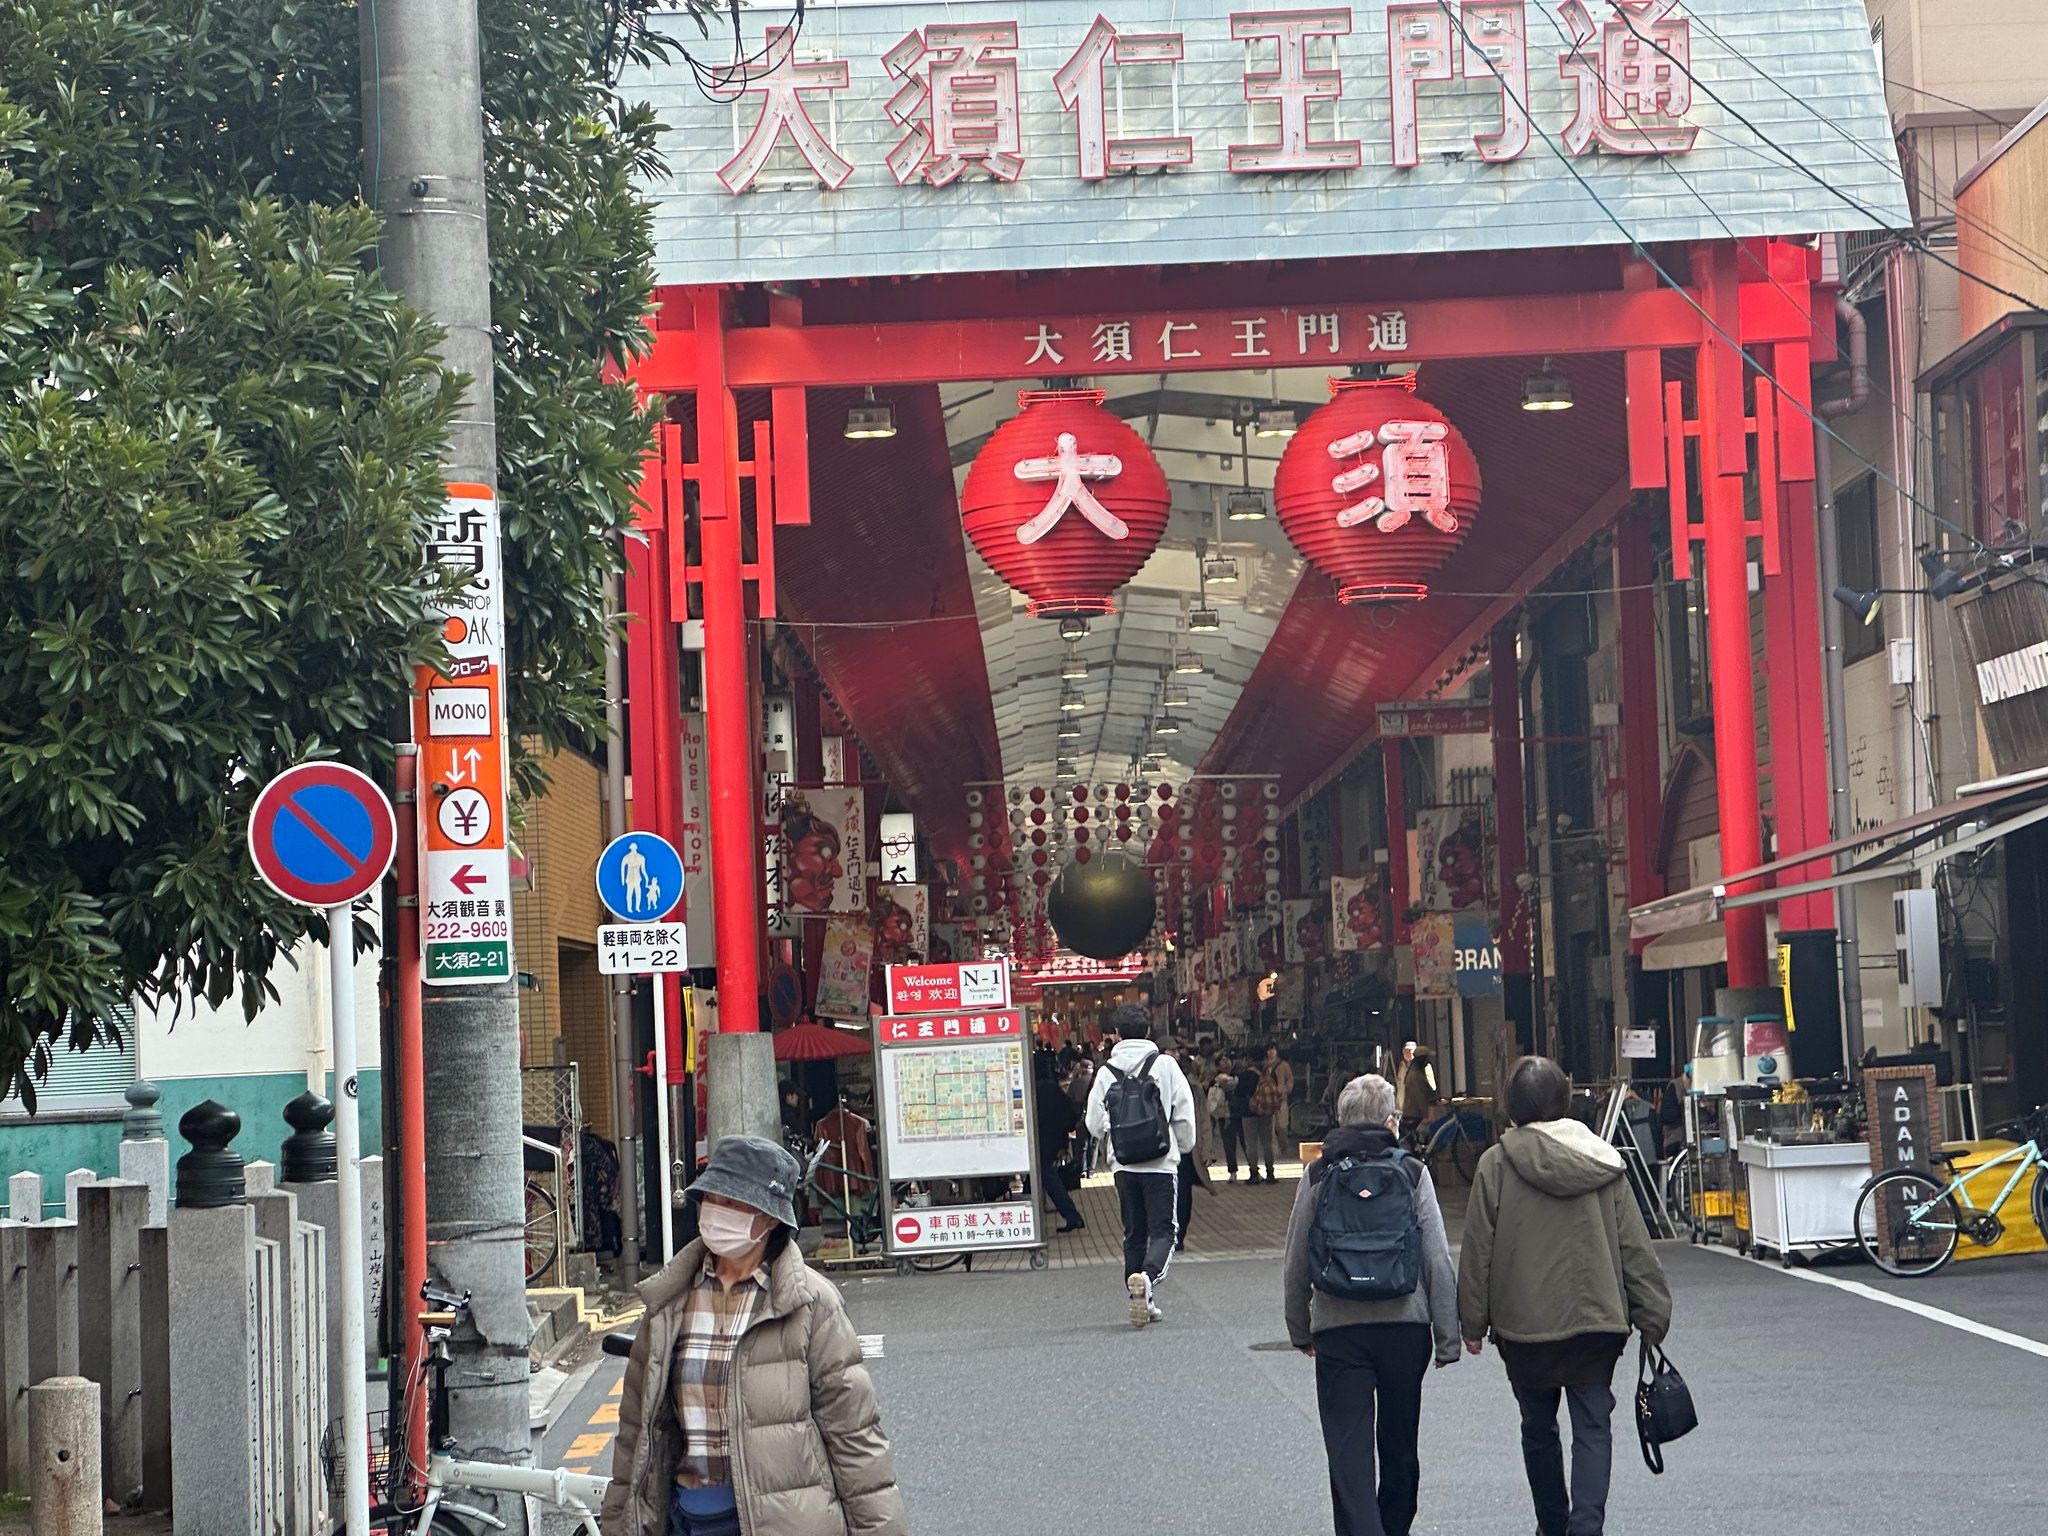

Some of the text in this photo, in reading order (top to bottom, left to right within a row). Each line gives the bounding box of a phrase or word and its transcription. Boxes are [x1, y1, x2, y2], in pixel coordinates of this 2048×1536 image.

[711, 0, 1700, 196] 大須仁王門通
[1023, 311, 1410, 367] 大須仁王門通
[1326, 419, 1459, 534] 須
[1013, 431, 1130, 545] 大
[449, 658, 488, 678] クローク
[435, 703, 487, 720] MONO
[844, 796, 863, 907] 大須仁王門通り
[428, 900, 490, 920] 大須観音
[427, 921, 508, 940] 222-9609
[603, 928, 681, 947] 軽車両を除く
[435, 951, 504, 970] 大須2-21
[903, 976, 953, 987] Welcome
[963, 969, 1000, 987] N-1
[928, 988, 958, 1000] 欢迎
[892, 1016, 1010, 1039] 仁王門通り
[929, 1211, 1032, 1230] 車両進入禁止
